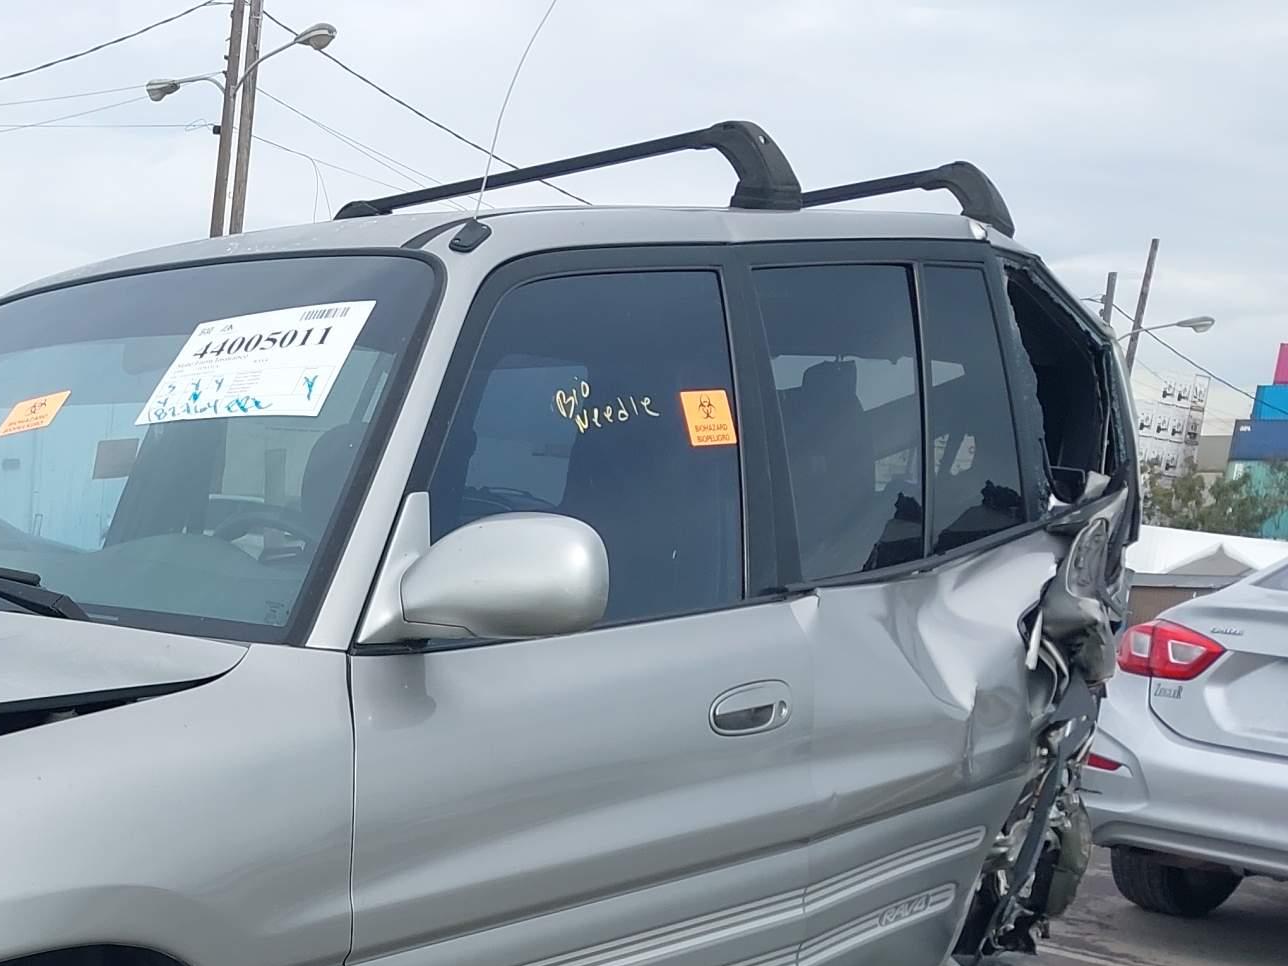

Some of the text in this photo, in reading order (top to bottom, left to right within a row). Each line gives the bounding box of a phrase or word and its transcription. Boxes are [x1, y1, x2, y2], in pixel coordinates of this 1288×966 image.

[193, 326, 334, 359] 44005011
[574, 396, 660, 433] Needle
[694, 423, 728, 433] BIOHAZARD
[696, 434, 730, 443] BIOPELIGRO
[881, 894, 928, 926] RAV4
